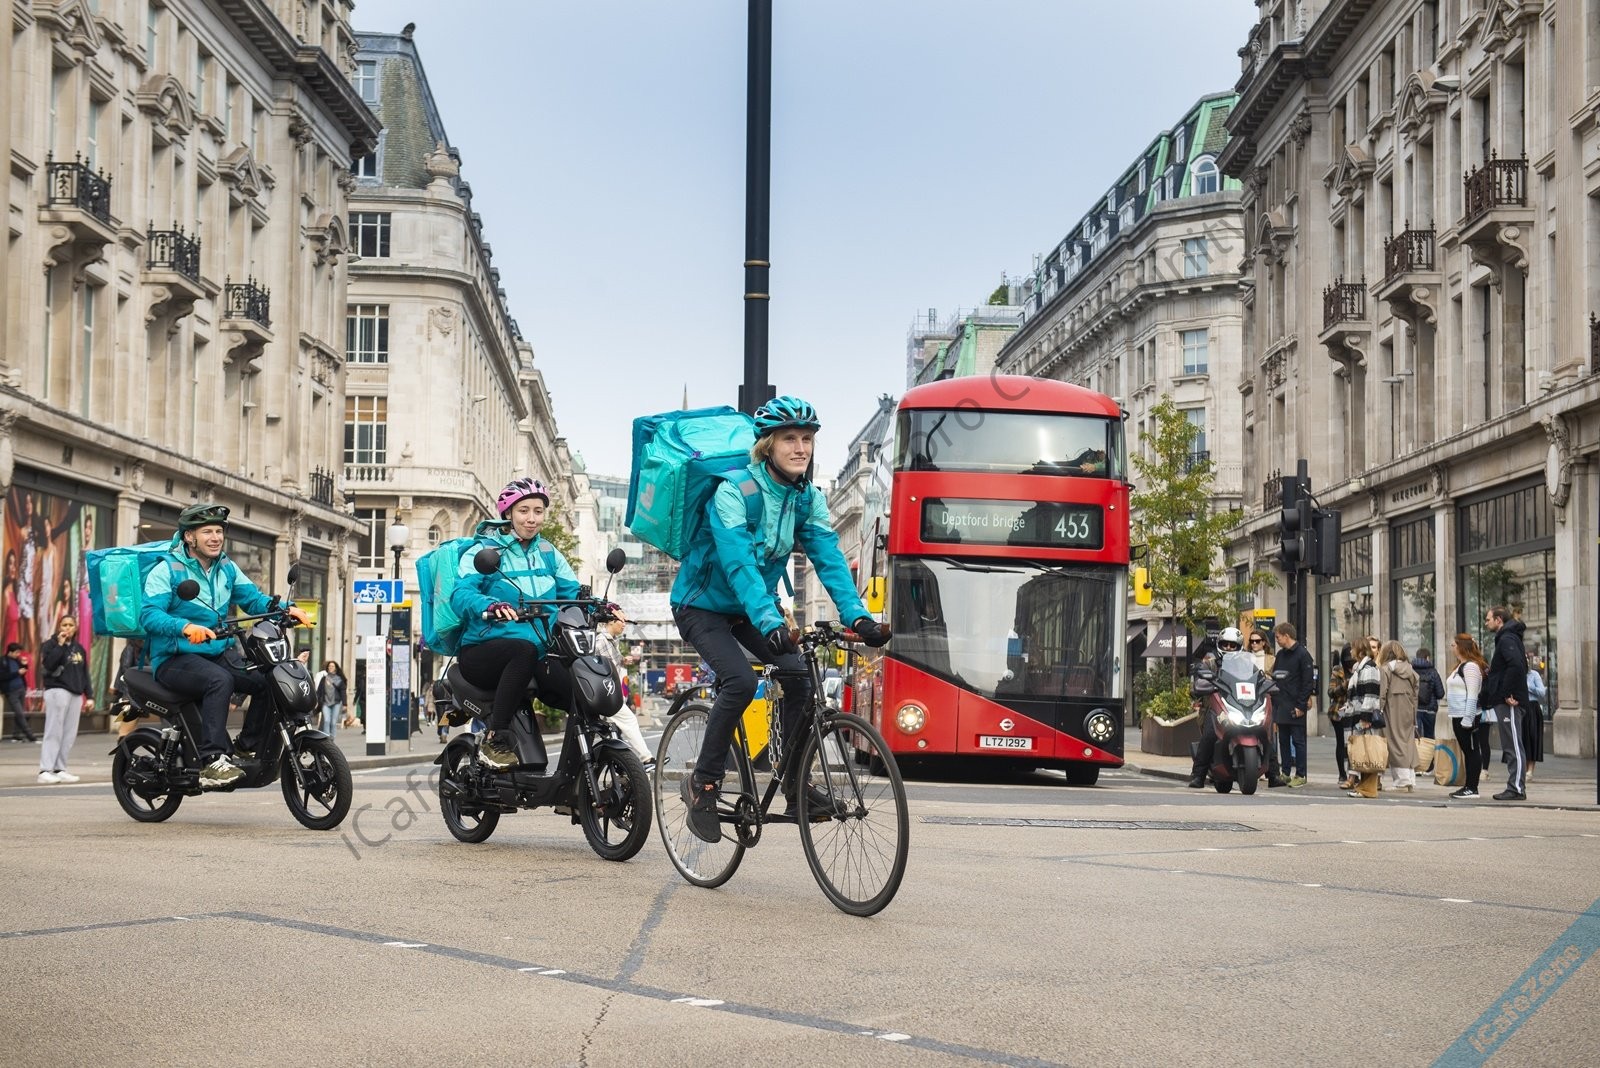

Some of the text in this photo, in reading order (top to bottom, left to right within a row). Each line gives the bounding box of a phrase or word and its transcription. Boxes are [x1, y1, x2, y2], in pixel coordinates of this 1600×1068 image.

[941, 512, 1090, 539] Deptford Bridge 453
[1241, 685, 1251, 694] L
